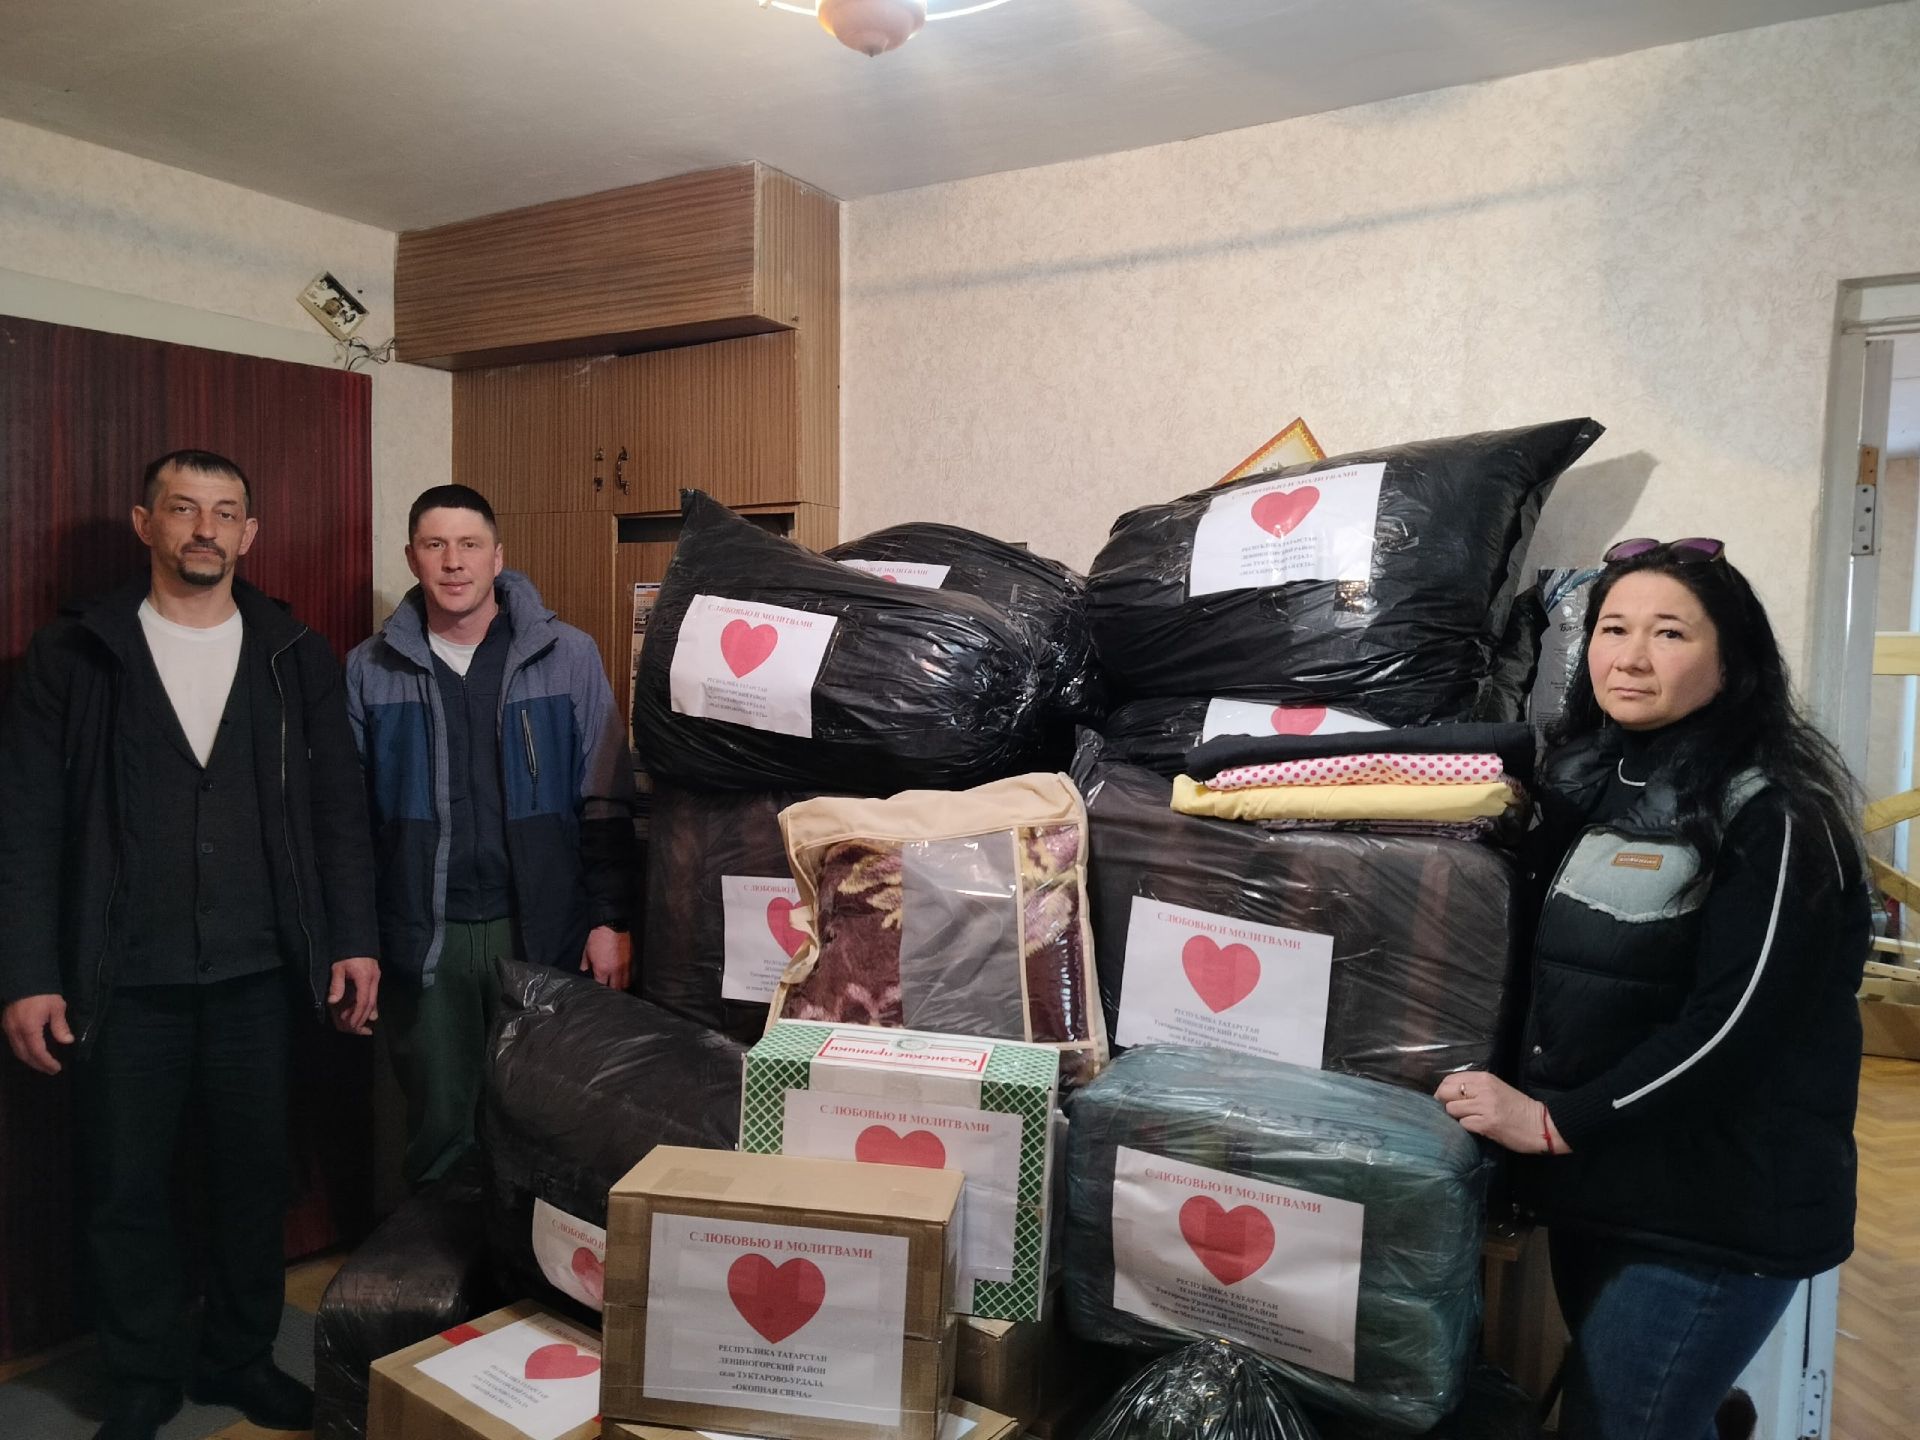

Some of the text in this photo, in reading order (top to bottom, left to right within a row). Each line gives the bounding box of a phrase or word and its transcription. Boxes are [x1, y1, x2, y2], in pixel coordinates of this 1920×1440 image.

[1157, 912, 1302, 950] С ЛЮБОВЬЮ И МОЛИТВАМИ
[820, 1104, 990, 1133] С ЛЮБОВЬЮ И МОЛИТВАМИ
[1144, 1168, 1322, 1214] С ЛЮБОВЬЮ И МОЛИТВАМИ
[690, 1231, 874, 1259] С ЛЮБОВЬЮ И МОЛИТВАМИ
[718, 1344, 828, 1363] РЕСПУБЛИКА ТАТАРСТАН
[718, 1357, 827, 1376] ЛЕНИНОГОРСКИЙ РАЙОН
